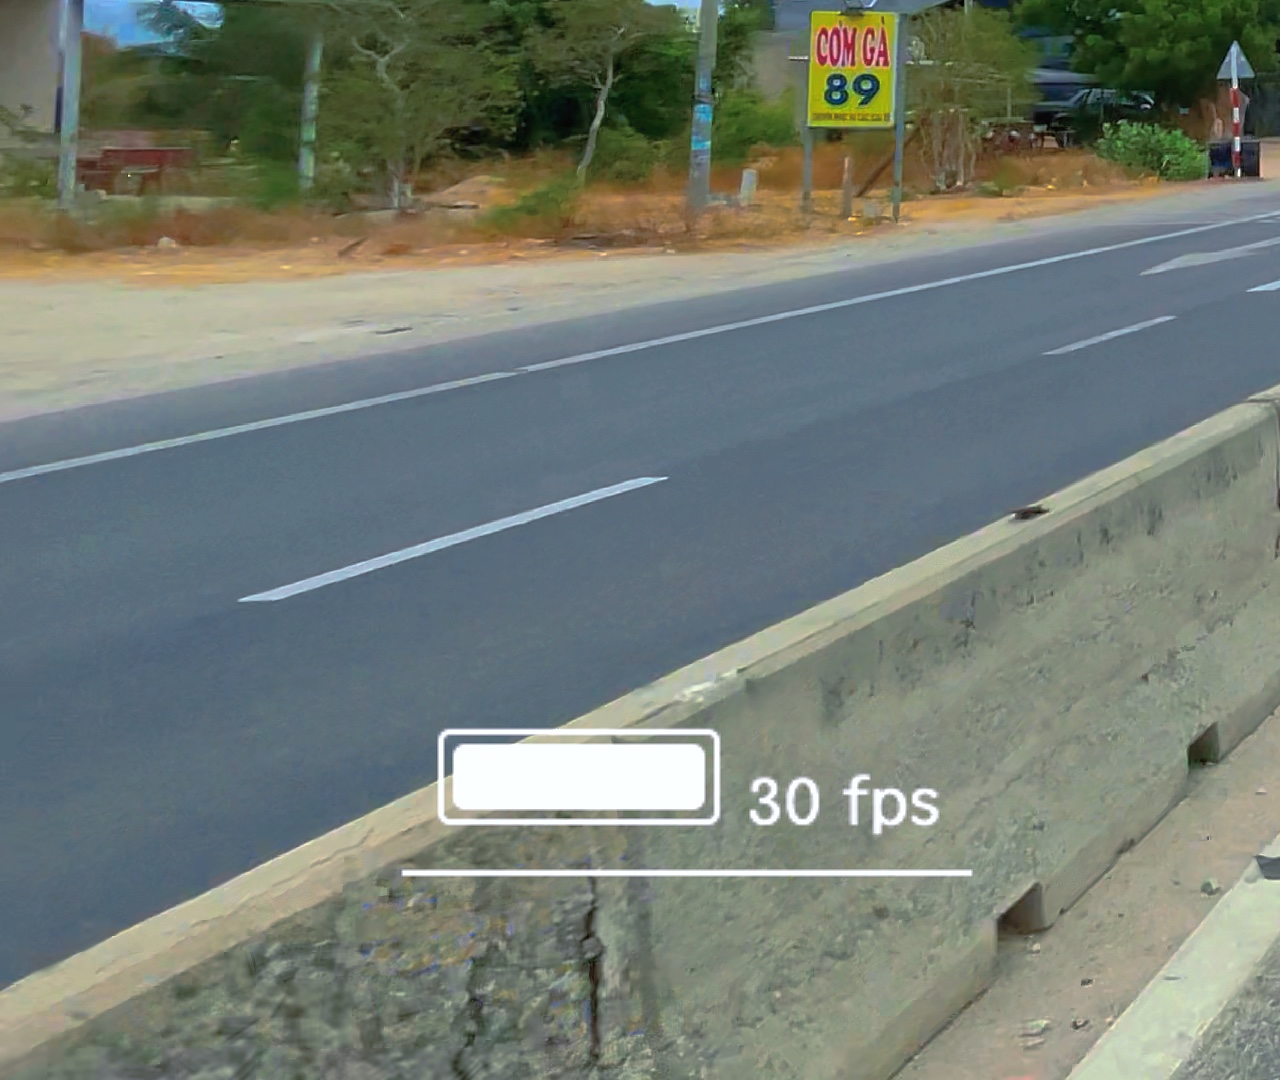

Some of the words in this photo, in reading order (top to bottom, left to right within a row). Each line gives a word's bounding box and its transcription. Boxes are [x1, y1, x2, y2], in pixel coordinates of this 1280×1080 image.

[816, 20, 857, 67] CƠM
[862, 15, 890, 67] GÀ
[824, 73, 881, 106] 89
